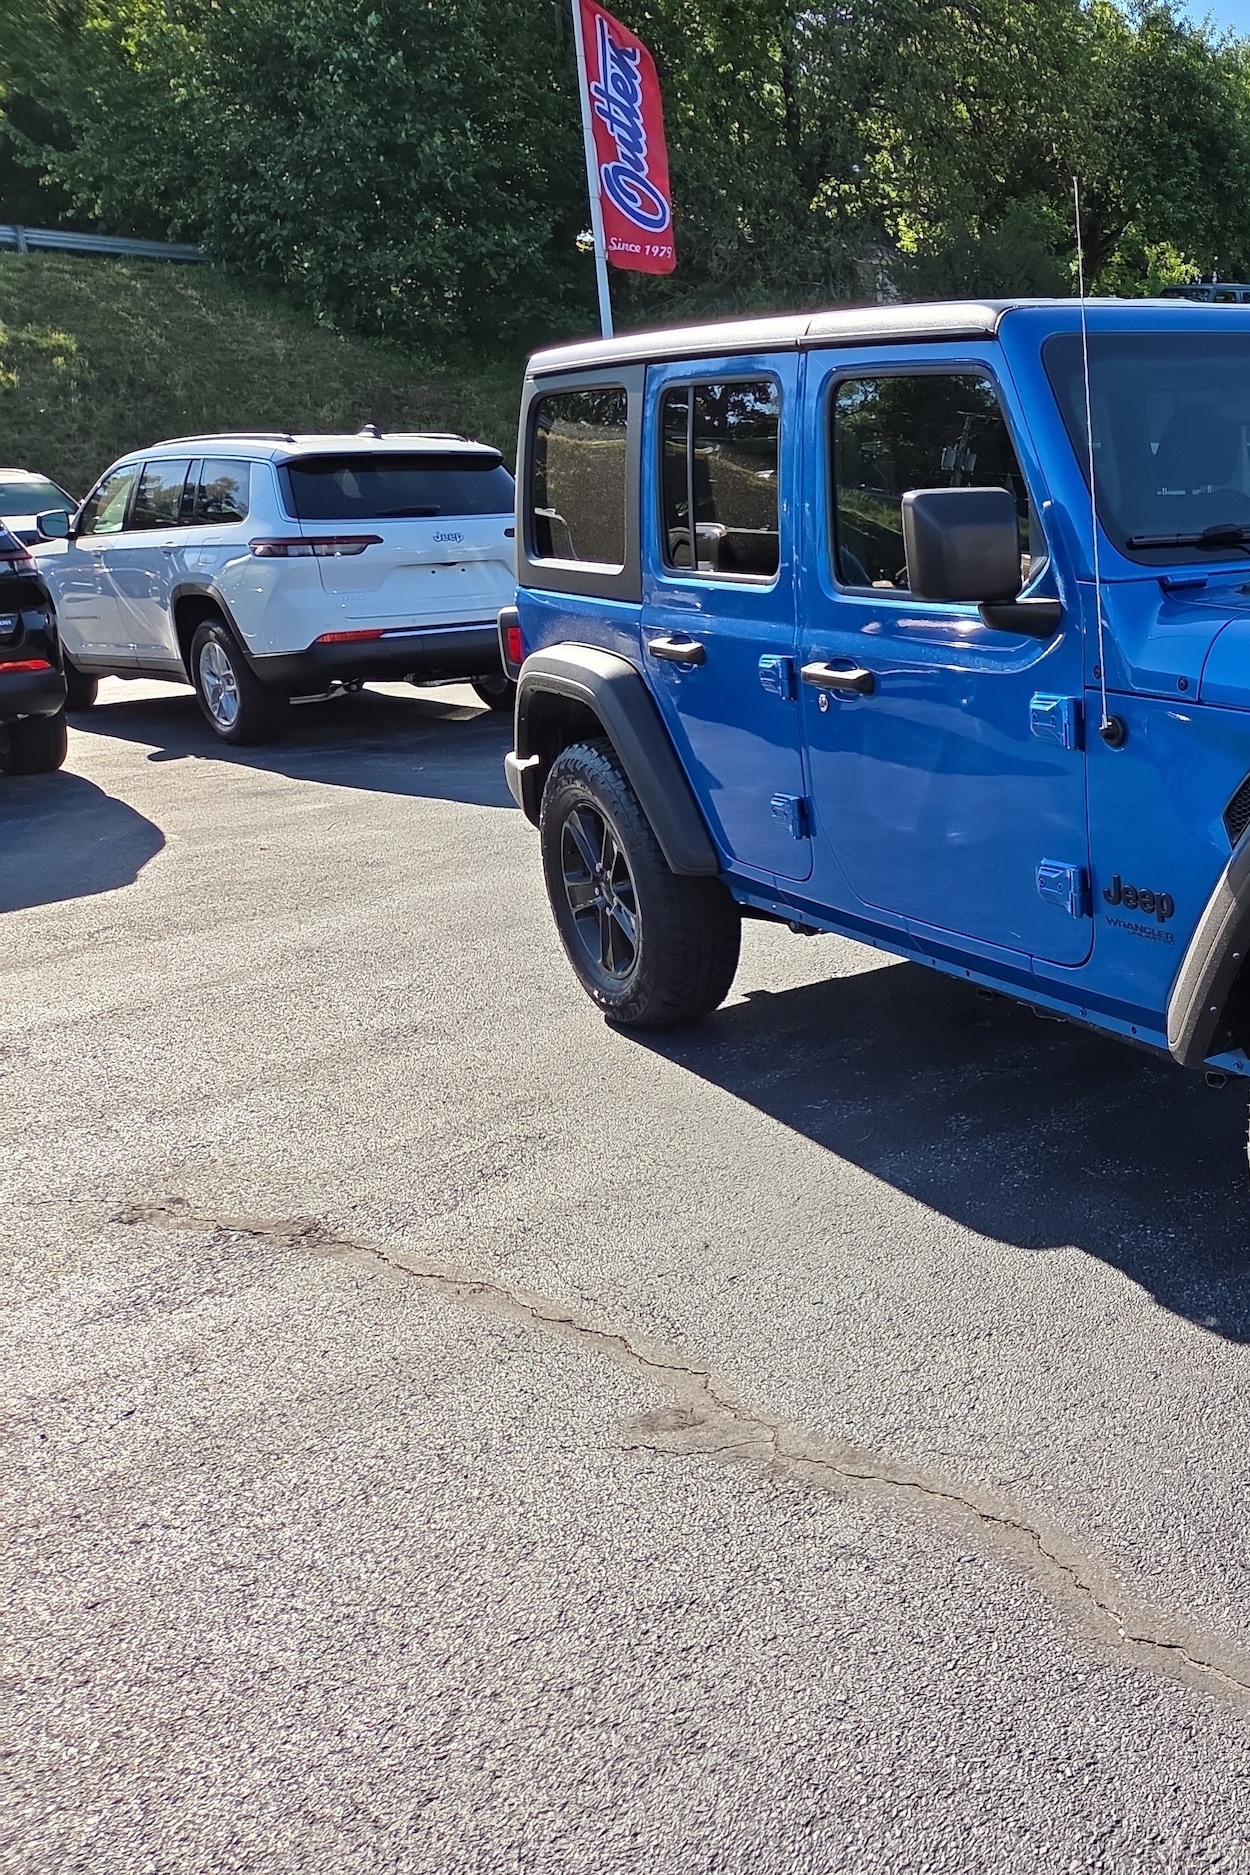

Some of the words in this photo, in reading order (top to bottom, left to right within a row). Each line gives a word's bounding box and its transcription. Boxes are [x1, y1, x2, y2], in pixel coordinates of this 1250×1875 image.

[590, 14, 670, 232] Outten
[608, 237, 641, 254] Since
[645, 244, 672, 259] 1979
[433, 531, 464, 544] Jeep
[1103, 873, 1175, 923] Jeep
[1105, 915, 1175, 941] WRANGLER
